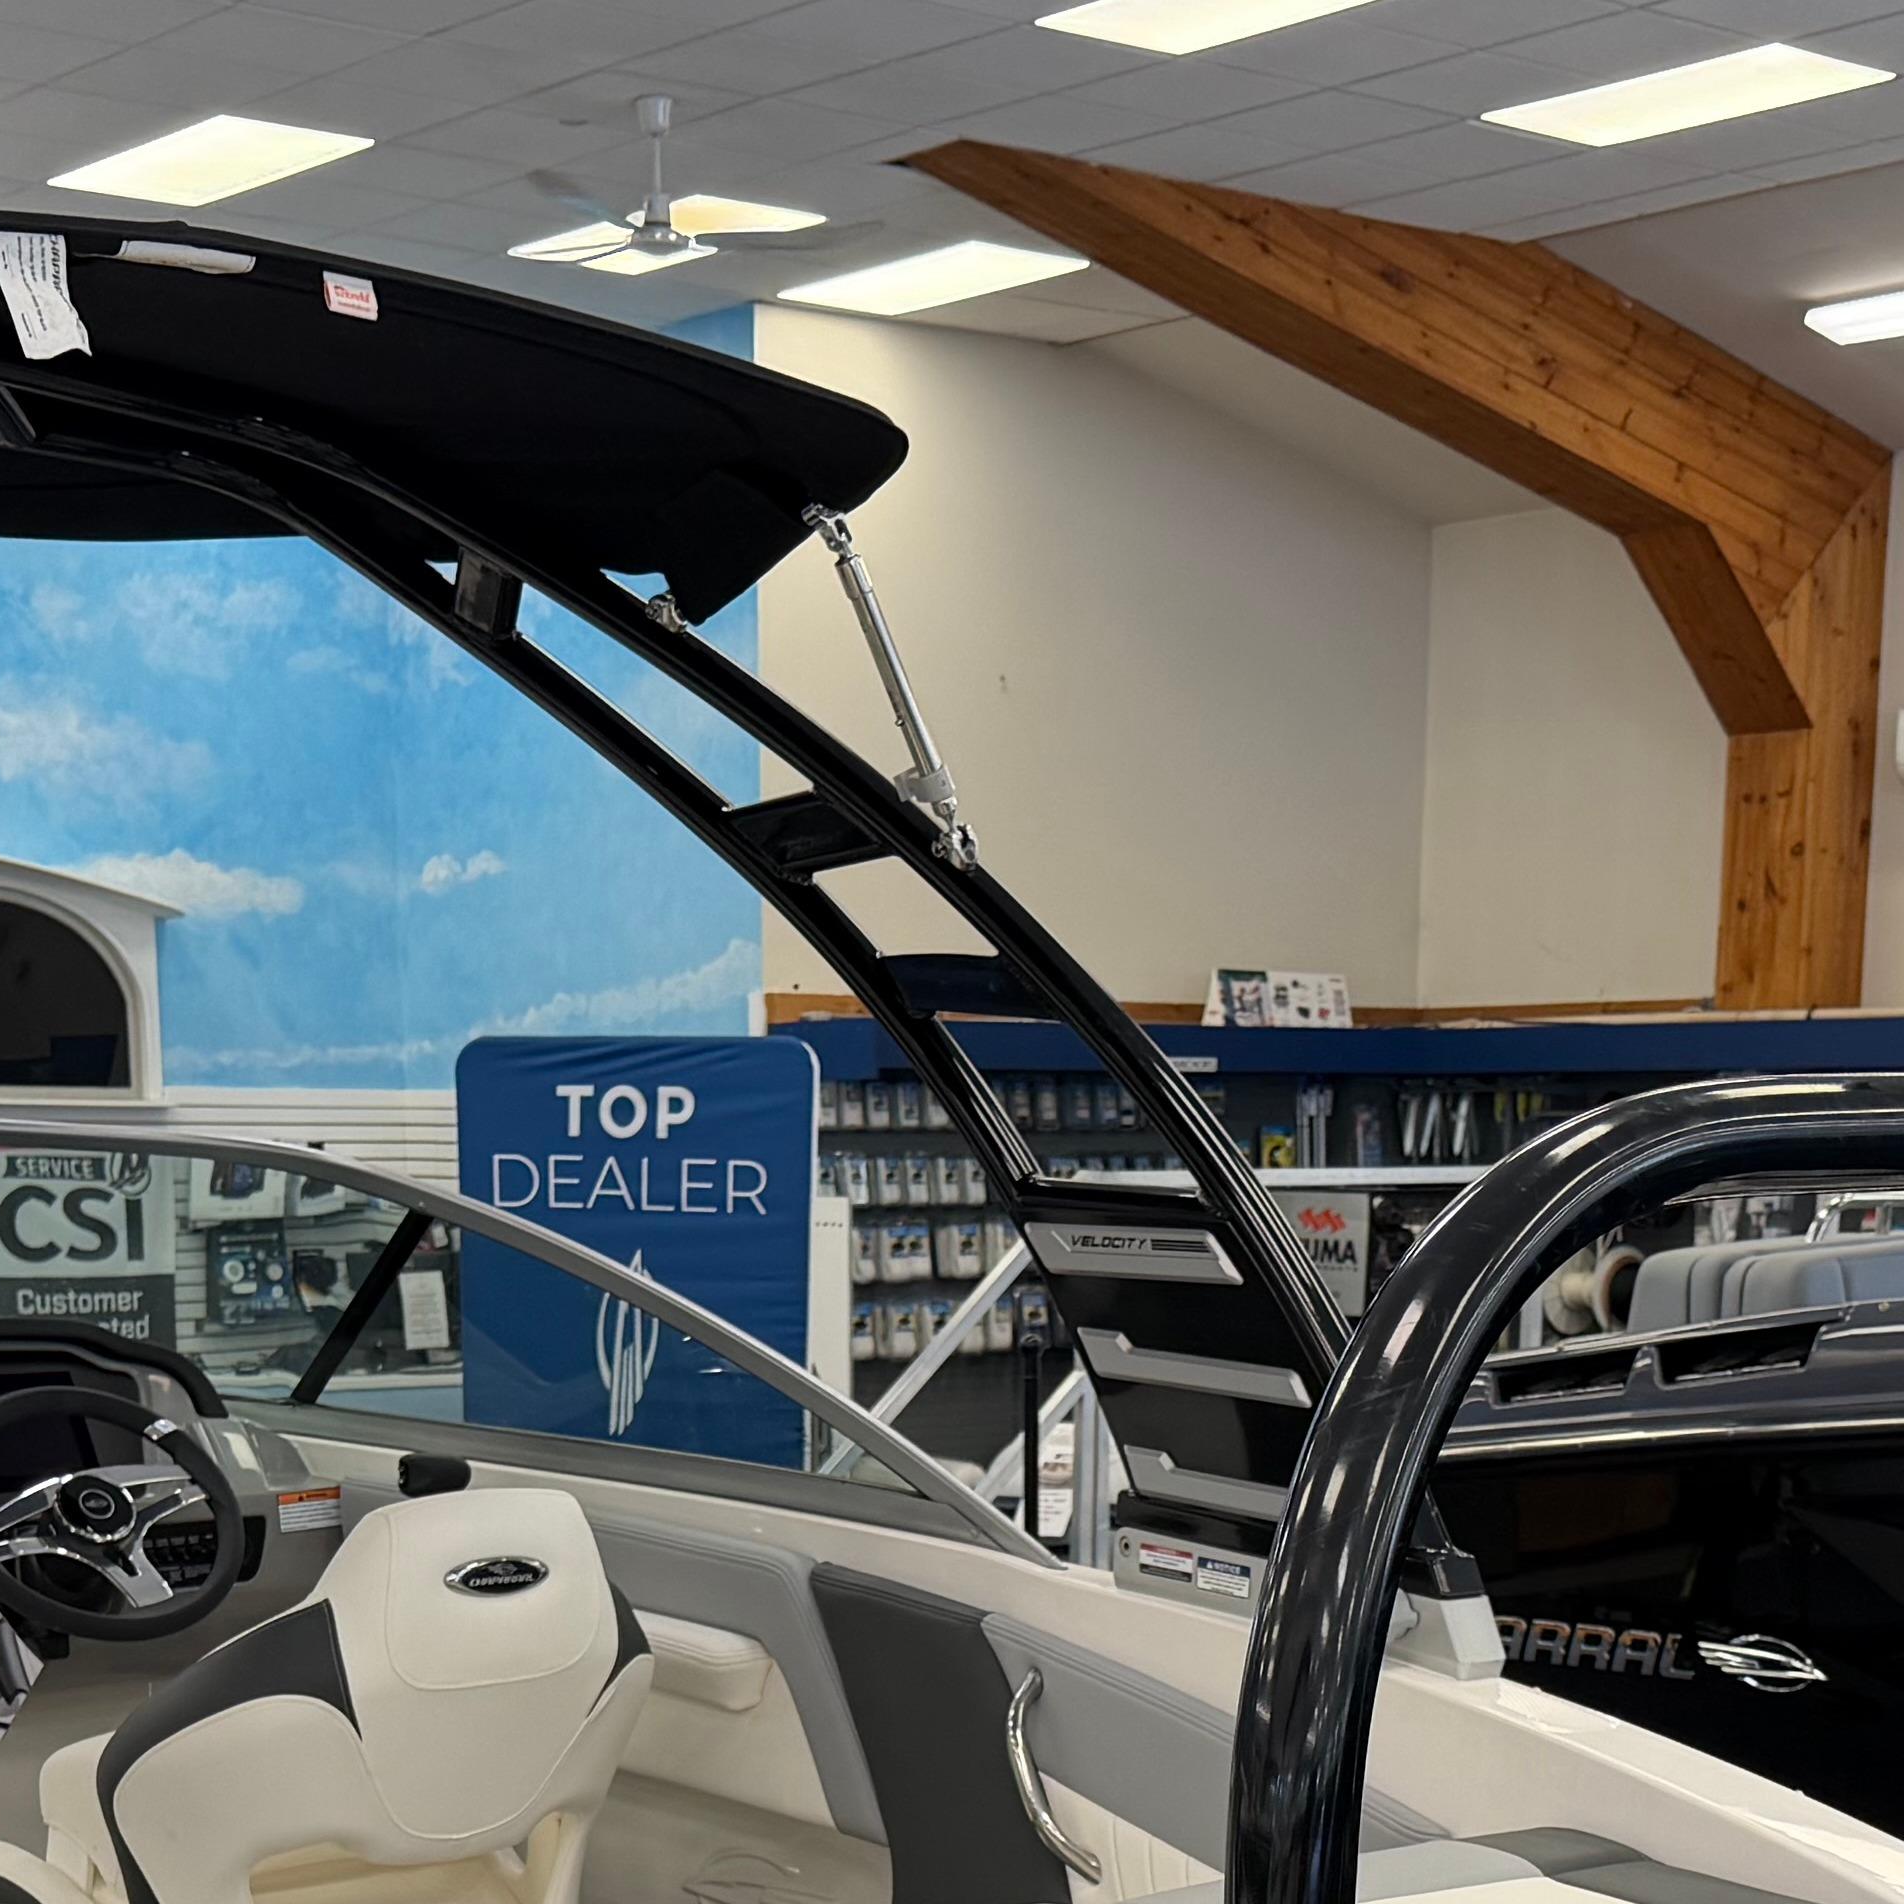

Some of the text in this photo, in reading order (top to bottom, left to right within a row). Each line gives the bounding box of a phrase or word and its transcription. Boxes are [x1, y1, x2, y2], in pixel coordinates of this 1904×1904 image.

[555, 1084, 696, 1139] TOP
[15, 1158, 94, 1179] SERVICE
[492, 1153, 768, 1216] DEALER
[1070, 1234, 1147, 1249] VELOCITY
[16, 1288, 144, 1315] Customer
[1494, 1615, 1696, 1680] ARRAL
